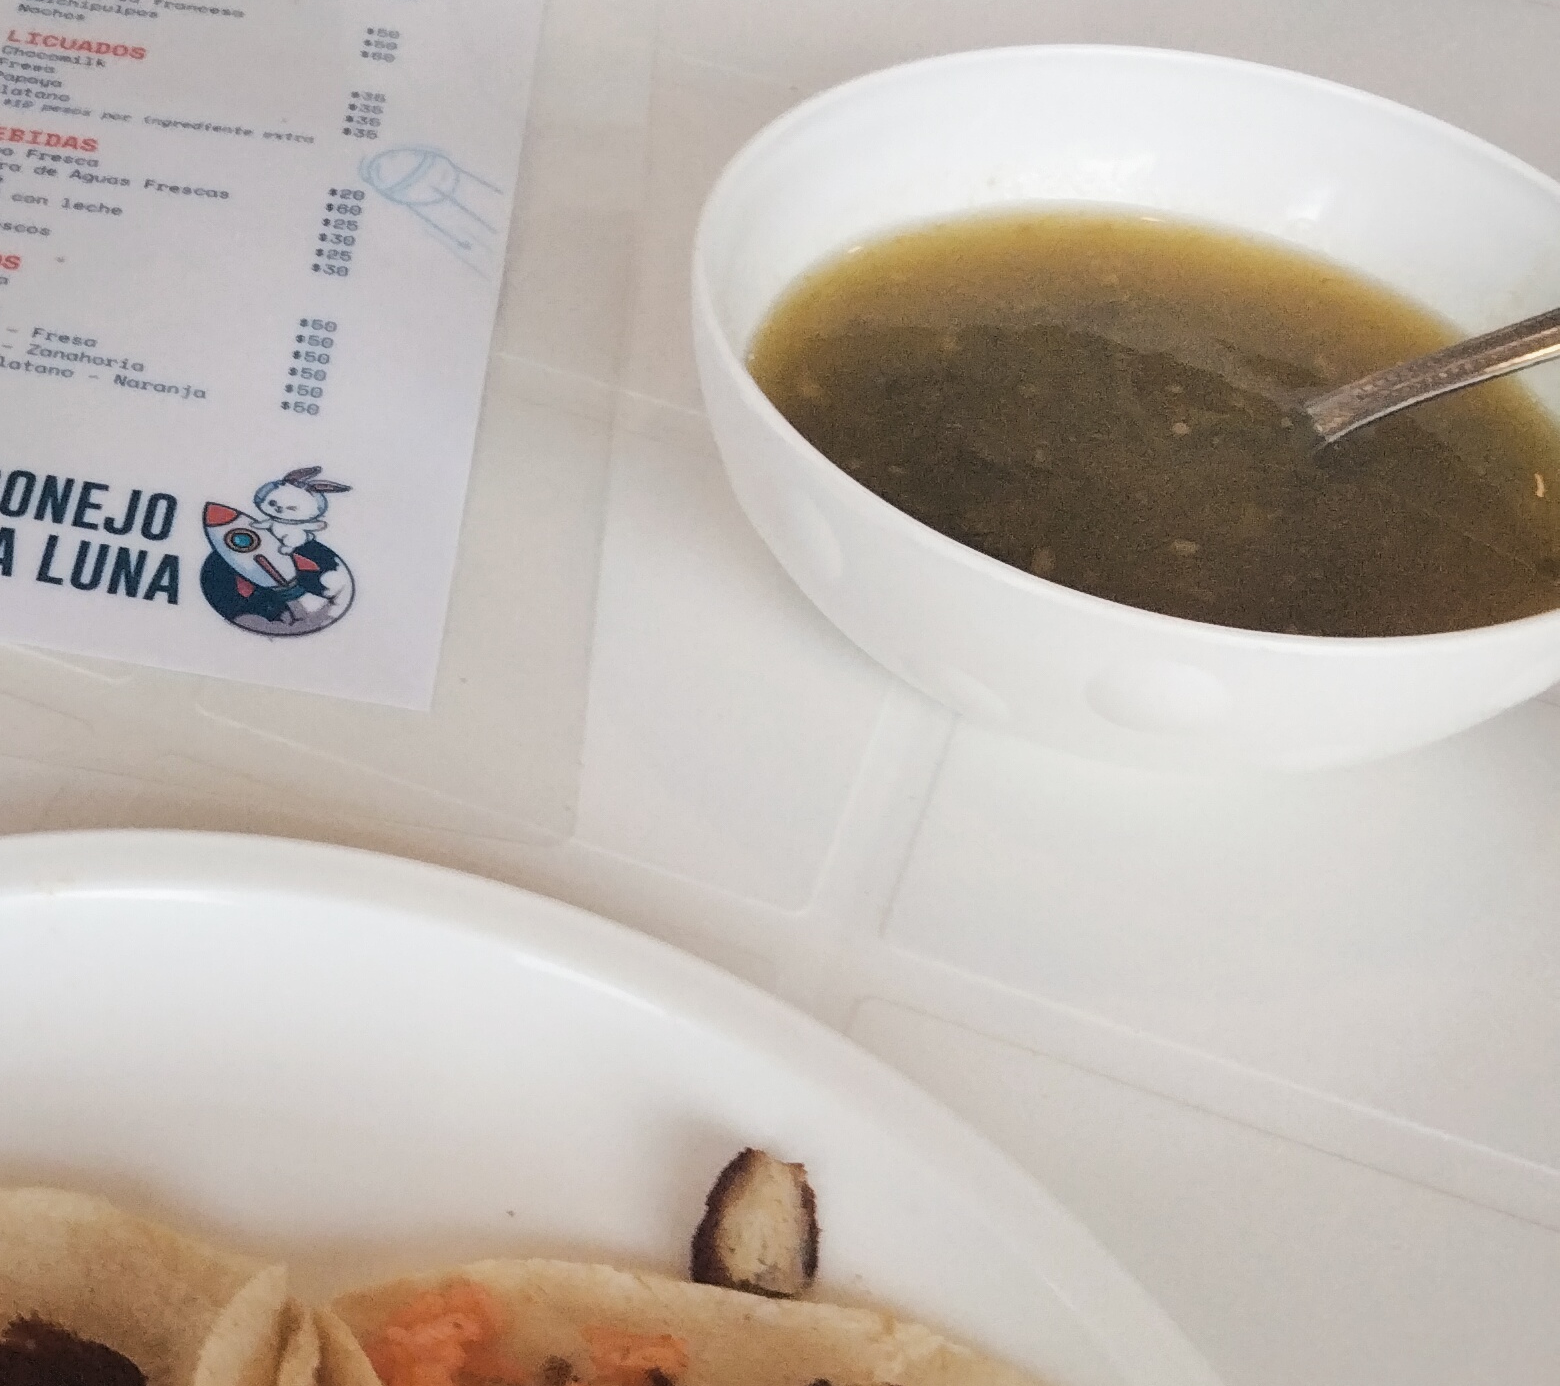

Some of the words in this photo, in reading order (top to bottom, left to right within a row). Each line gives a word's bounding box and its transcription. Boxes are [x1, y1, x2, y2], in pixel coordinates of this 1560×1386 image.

[17, 3, 85, 20] Nachos
[6, 29, 148, 61] LICUADOS
[2, 45, 106, 68] Chocomilk
[26, 148, 99, 167] Fresca
[34, 166, 58, 176] de
[69, 169, 130, 186] Aguas
[143, 178, 229, 199] Frescas
[328, 187, 365, 202] $20
[11, 193, 48, 206] con
[61, 198, 123, 216] leche
[324, 202, 362, 216] $60
[321, 218, 358, 231] $25
[318, 233, 356, 246] $30
[315, 248, 352, 262] $25
[310, 263, 350, 277] $30
[298, 318, 338, 333] $50
[31, 327, 98, 348] Fresa
[295, 334, 334, 349] $50
[26, 343, 145, 372] Zanahoria
[292, 350, 330, 365] $50
[288, 367, 326, 381] $50
[113, 374, 206, 399] Naranja
[284, 383, 323, 399] $50
[280, 400, 320, 416] $50
[36, 533, 180, 606] LUNA
